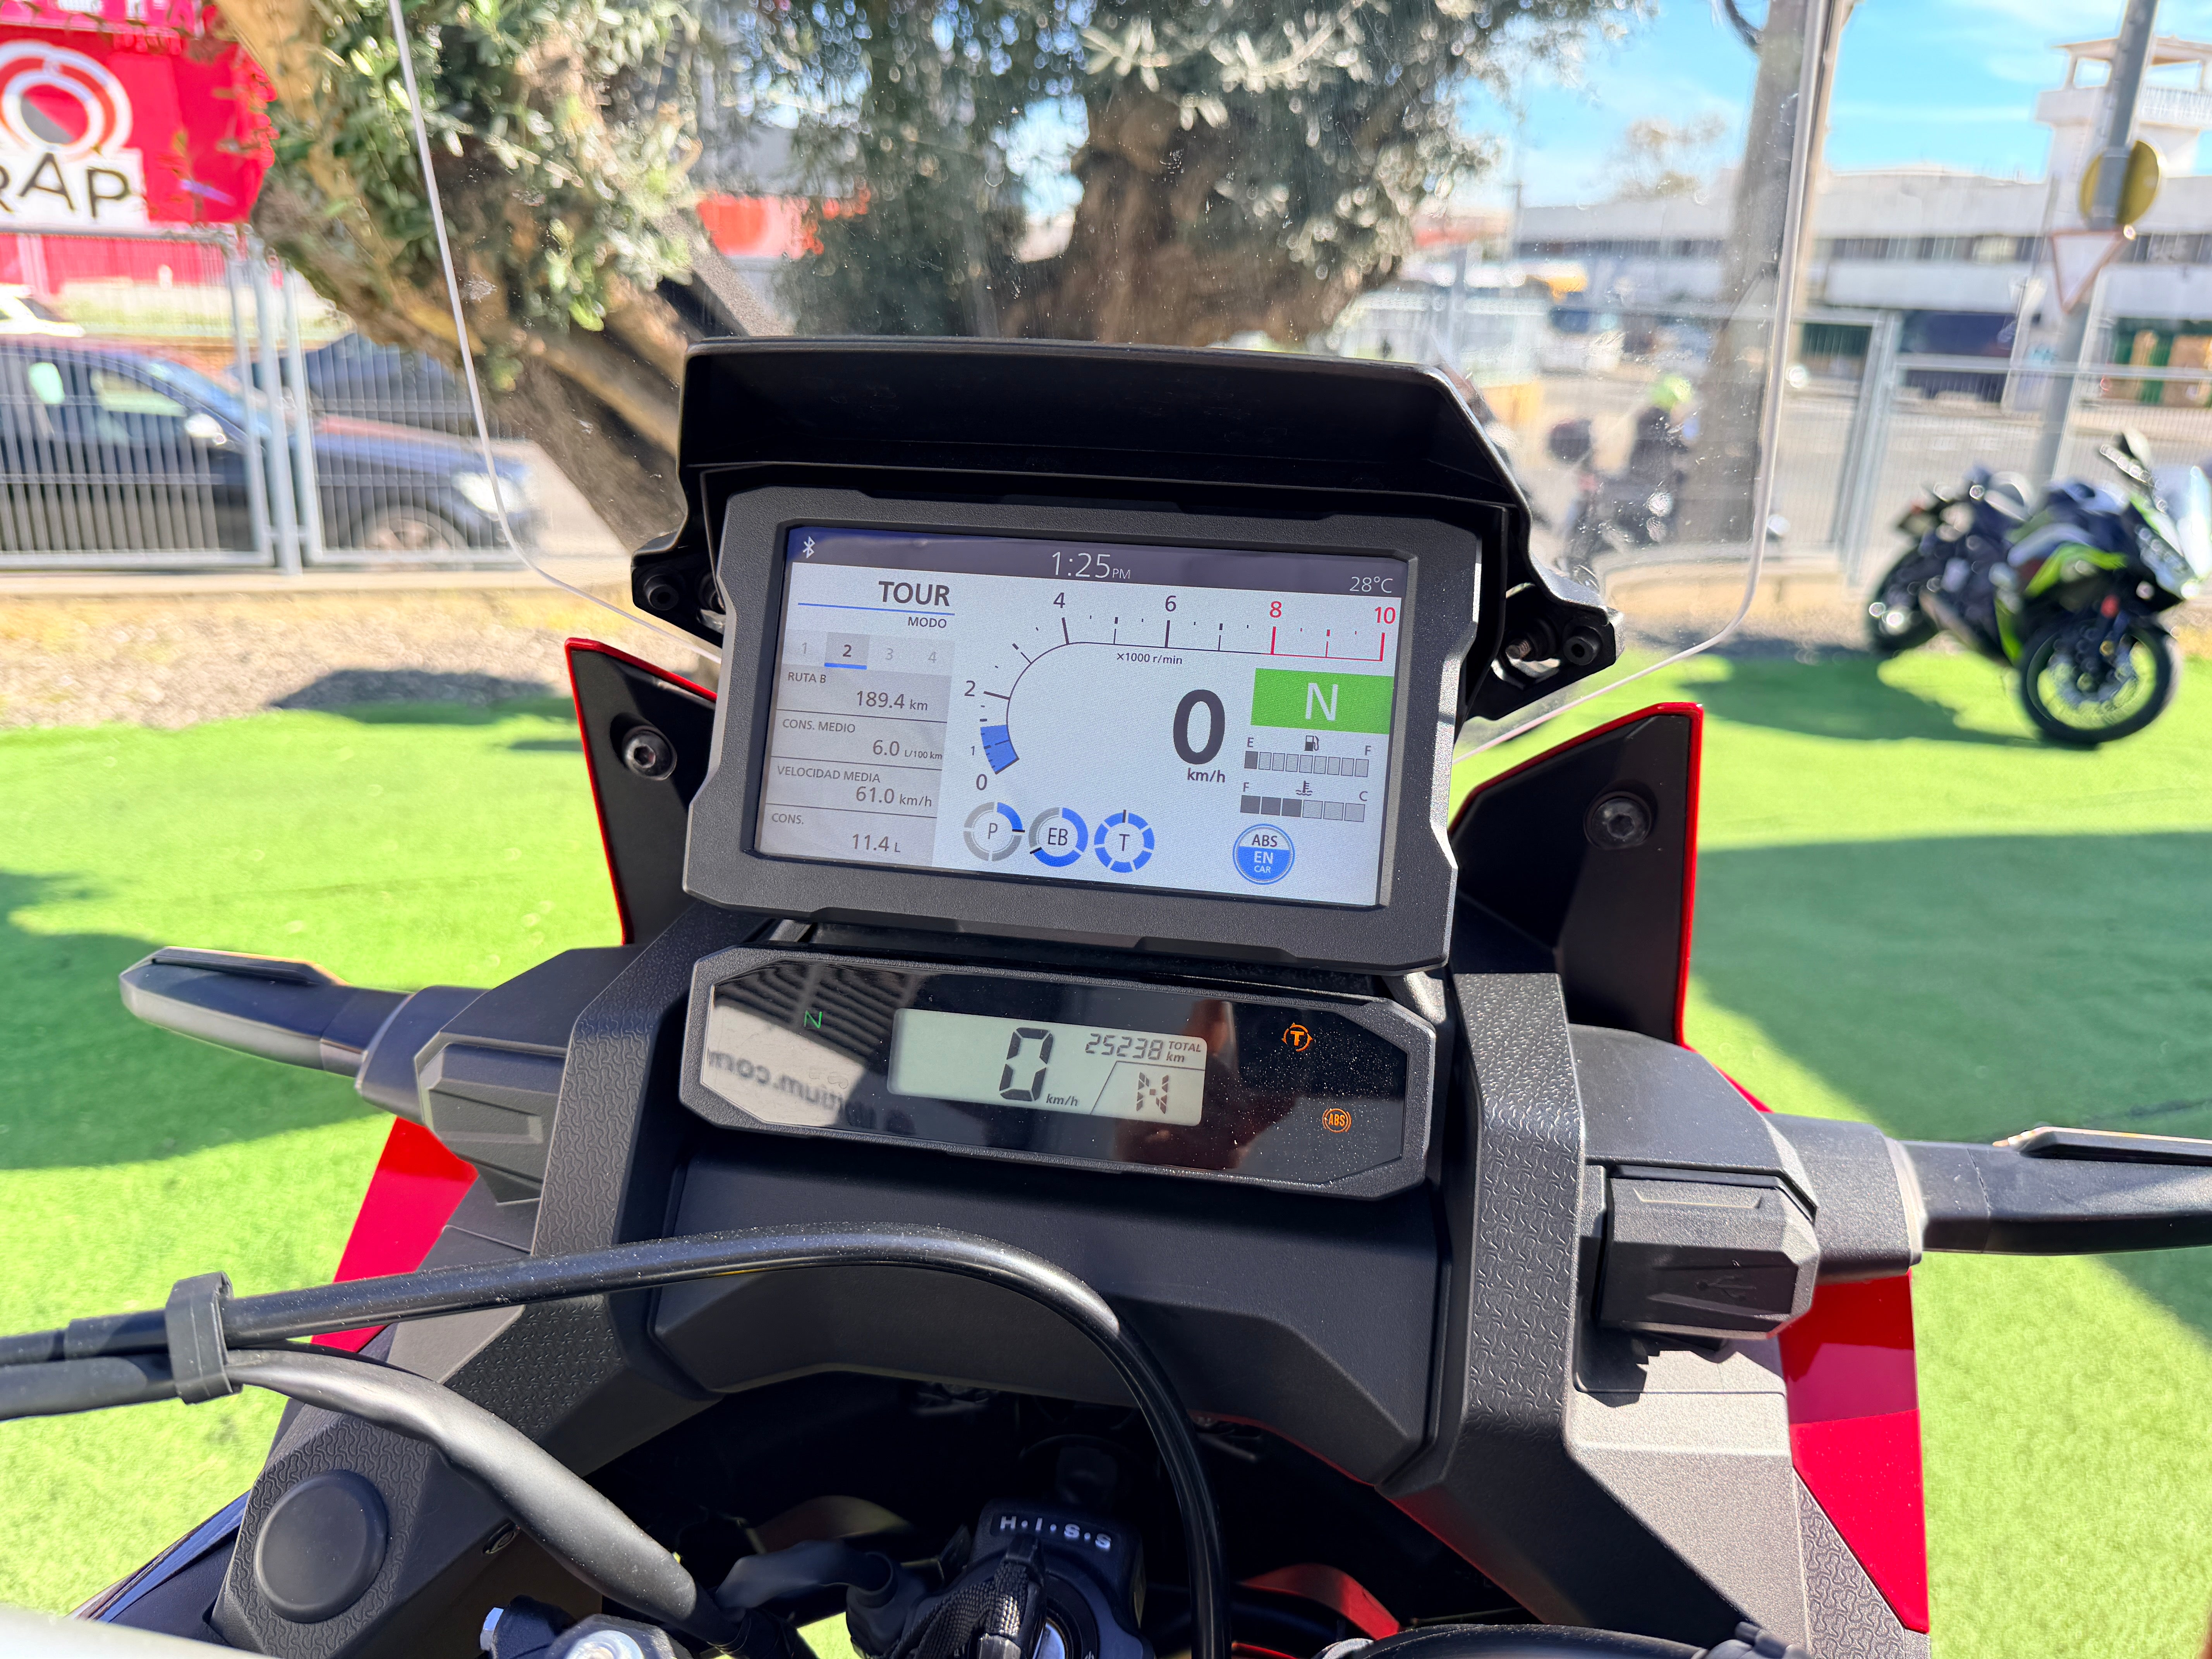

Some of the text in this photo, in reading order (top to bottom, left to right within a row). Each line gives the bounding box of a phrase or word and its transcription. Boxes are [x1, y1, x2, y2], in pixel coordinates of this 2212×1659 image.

[1052, 551, 1131, 580] 1:25 PM
[878, 580, 950, 606] TOUR
[1349, 576, 1393, 594] 28°C
[1053, 592, 1066, 608] 4
[1165, 595, 1176, 612] 6
[1269, 601, 1282, 618] 8
[1374, 606, 1396, 624] 10
[908, 617, 947, 629] MODO
[801, 642, 936, 663] 1 2 3 4
[1153, 653, 1183, 666] r/min
[788, 672, 826, 684] RUTA B
[964, 680, 975, 697] 2
[857, 690, 927, 711] 189.4 km
[1305, 683, 1338, 721] N
[783, 719, 855, 733] CONS. MEDIO
[1173, 689, 1225, 764] 0
[873, 740, 942, 759] 6.0 L/100 km
[970, 746, 975, 756] 1
[1247, 737, 1254, 748] E
[1365, 746, 1371, 756] F
[777, 766, 880, 783] VELOCIDAD MEDIA
[976, 774, 987, 791] 0
[1187, 768, 1226, 783] km/h
[1243, 782, 1249, 792] F
[856, 786, 932, 807] 61.0 km/h
[1359, 791, 1368, 802] C
[772, 813, 804, 824] CONS.
[988, 823, 998, 839] P
[1048, 828, 1068, 846] EB
[852, 834, 901, 853] 11.4 L
[1120, 834, 1130, 851] T
[1252, 834, 1278, 847] ABS
[1254, 851, 1273, 864] EN
[804, 1010, 823, 1029] N
[1085, 1033, 1202, 1060] 25238 TOTAL
[1166, 1051, 1185, 1063] km
[999, 1027, 1078, 1106] 0 km/h
[1136, 1071, 1169, 1114] N
[1328, 1114, 1345, 1126] ABS
